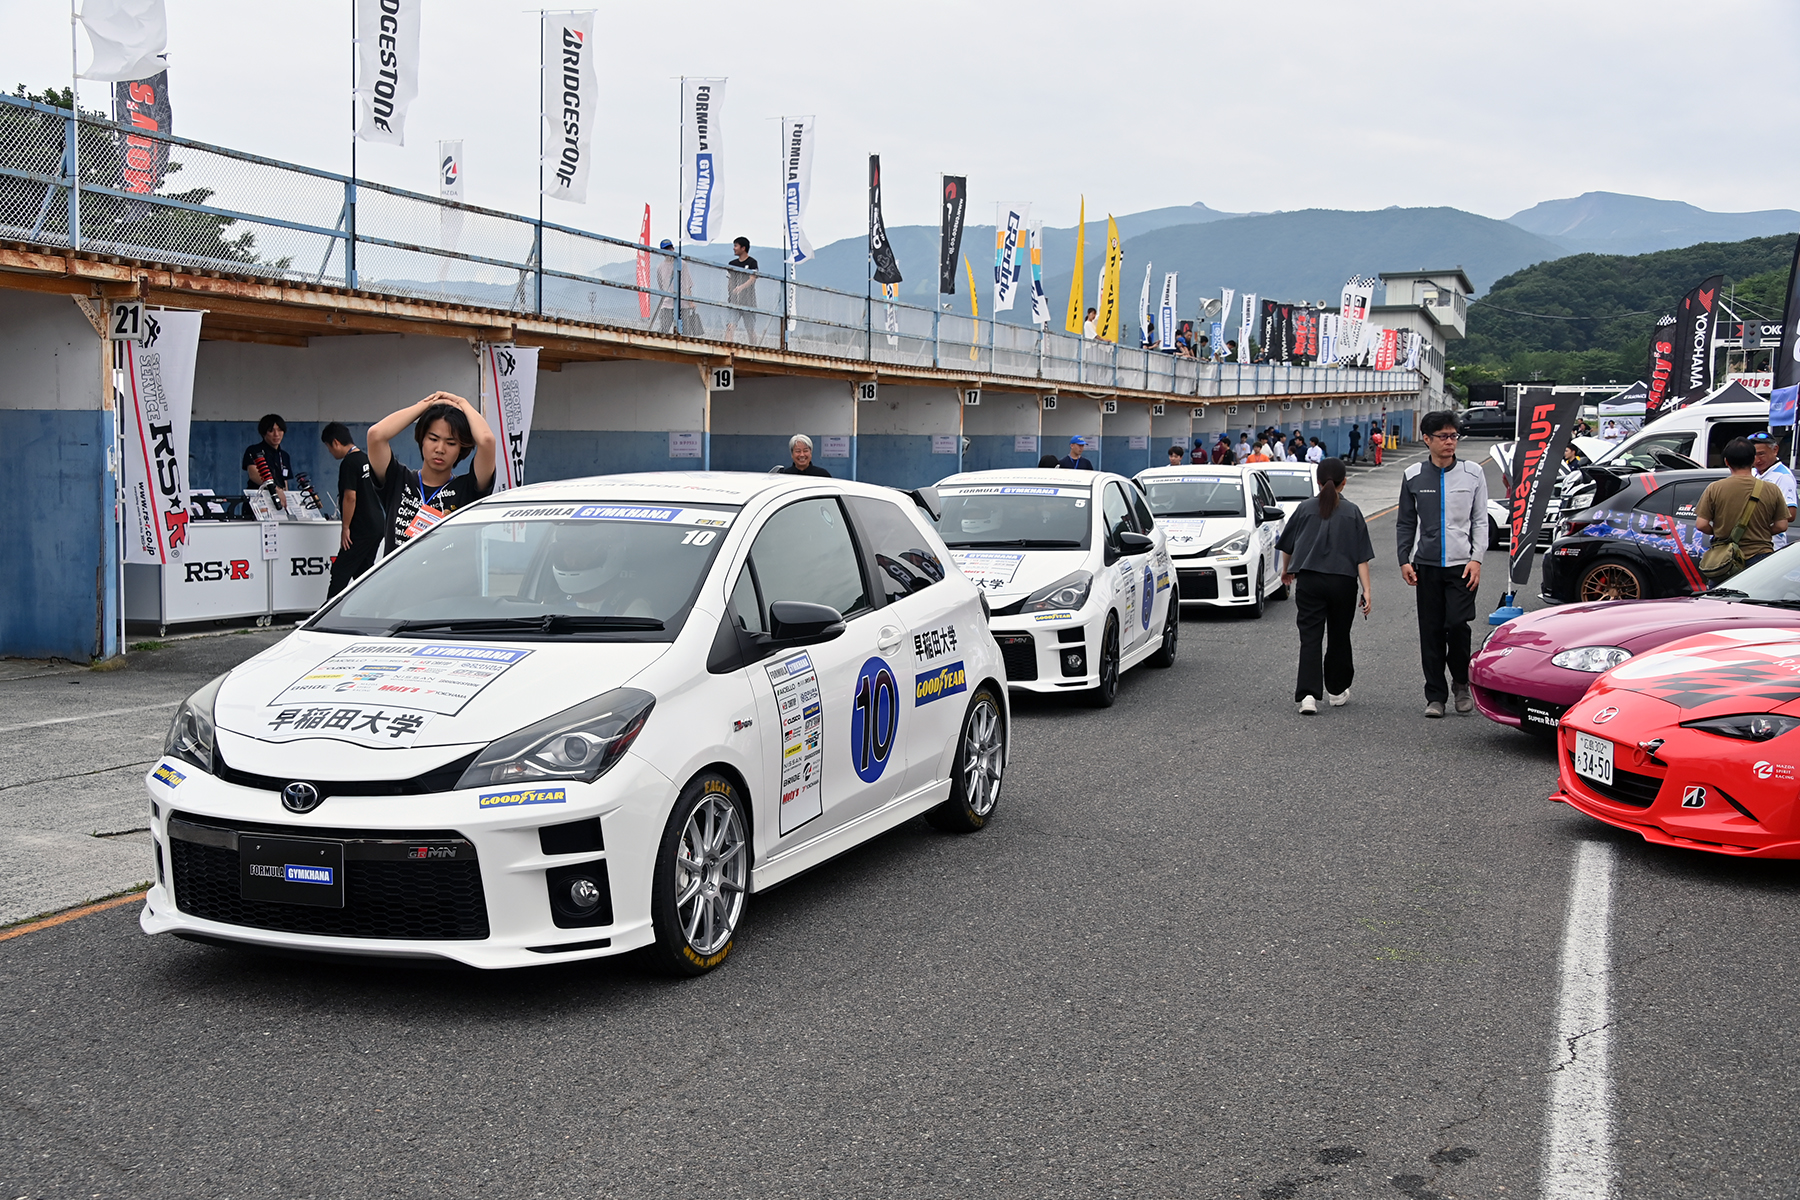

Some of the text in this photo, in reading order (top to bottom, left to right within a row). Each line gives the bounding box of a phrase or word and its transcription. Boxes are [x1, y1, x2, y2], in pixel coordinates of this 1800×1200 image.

[556, 26, 583, 189] BRIDGESTONE
[689, 85, 710, 235] FORMULA GYMKHANA
[788, 123, 804, 181] FORMULA
[787, 187, 800, 263] GYMKHANA
[999, 210, 1021, 303] GReddy
[115, 305, 139, 334] 21
[1689, 312, 1709, 389] YOKOHAMA
[714, 370, 730, 387] 19
[1730, 378, 1770, 388] oty's
[140, 355, 160, 421] SERVICE
[860, 384, 875, 399] 18
[967, 391, 978, 403] 17
[1044, 396, 1056, 408] 16
[502, 382, 515, 431] SERVICE
[1105, 402, 1115, 412] 15
[1154, 406, 1162, 414] 14
[1194, 408, 1202, 416] 13
[683, 486, 741, 495] Racing
[1075, 499, 1086, 508] 5
[139, 482, 156, 556] www.rs-r.co.jp
[502, 507, 672, 520] FORMULA GYMKHANA
[680, 530, 718, 546] 10
[914, 624, 958, 662] 早稲田大学
[422, 646, 516, 660] GYMKHANA
[916, 668, 965, 699] GOODYEAR
[856, 668, 896, 772] 10
[1527, 708, 1549, 716] POTENZA
[1528, 715, 1544, 724] SUPER
[268, 706, 424, 738] 早稲田大学
[784, 757, 802, 768] NISSAN
[1583, 752, 1611, 780] 34-50
[156, 766, 182, 785] GOODYEAR
[784, 773, 800, 787] BRIDE
[704, 780, 731, 796] EAGLE
[783, 788, 799, 804] Moty's
[480, 791, 564, 805] GOODYEAR
[408, 846, 457, 859] GRMN
[250, 864, 330, 882] FORMULA GYMKHANA
